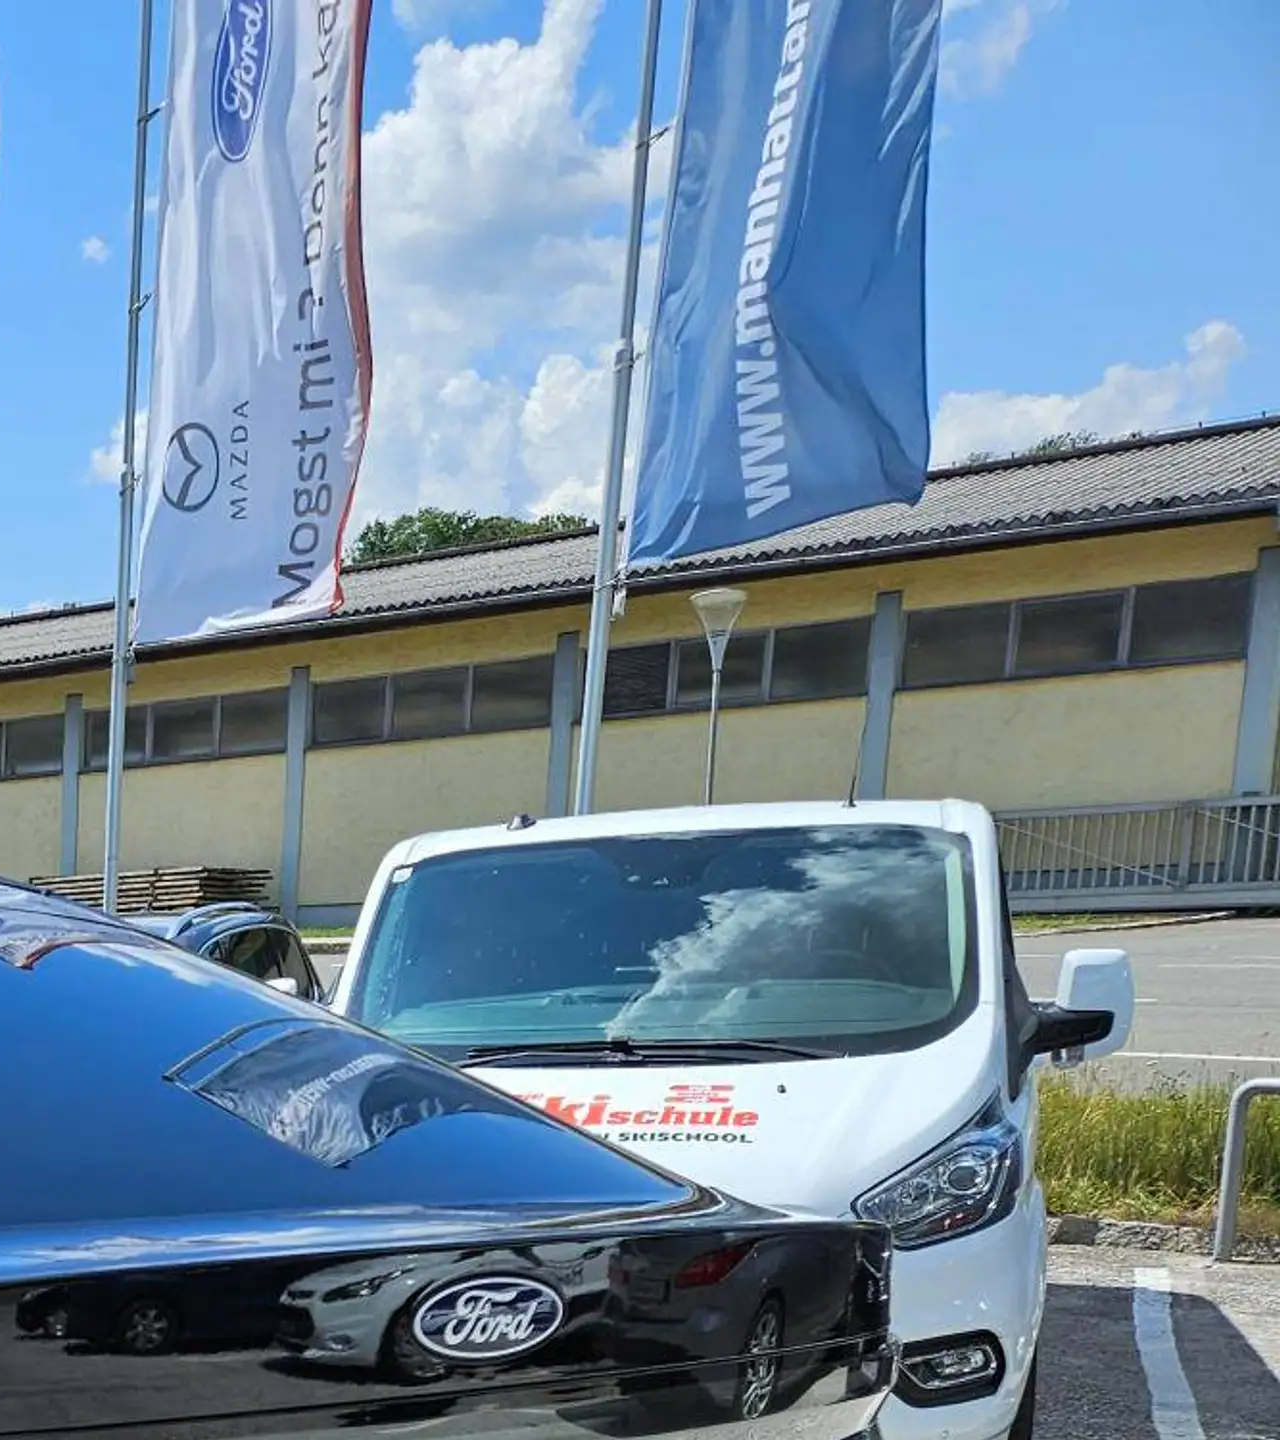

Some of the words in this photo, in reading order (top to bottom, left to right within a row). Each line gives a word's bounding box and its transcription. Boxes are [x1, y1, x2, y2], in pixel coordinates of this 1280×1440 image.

[222, 0, 264, 121] Ford
[292, 336, 334, 412] mi
[229, 399, 251, 521] MAZDA
[271, 427, 332, 609] Mogst
[544, 1093, 759, 1127] kischule
[618, 1131, 754, 1144] SKISCHOOL
[443, 1289, 535, 1346] Ford
